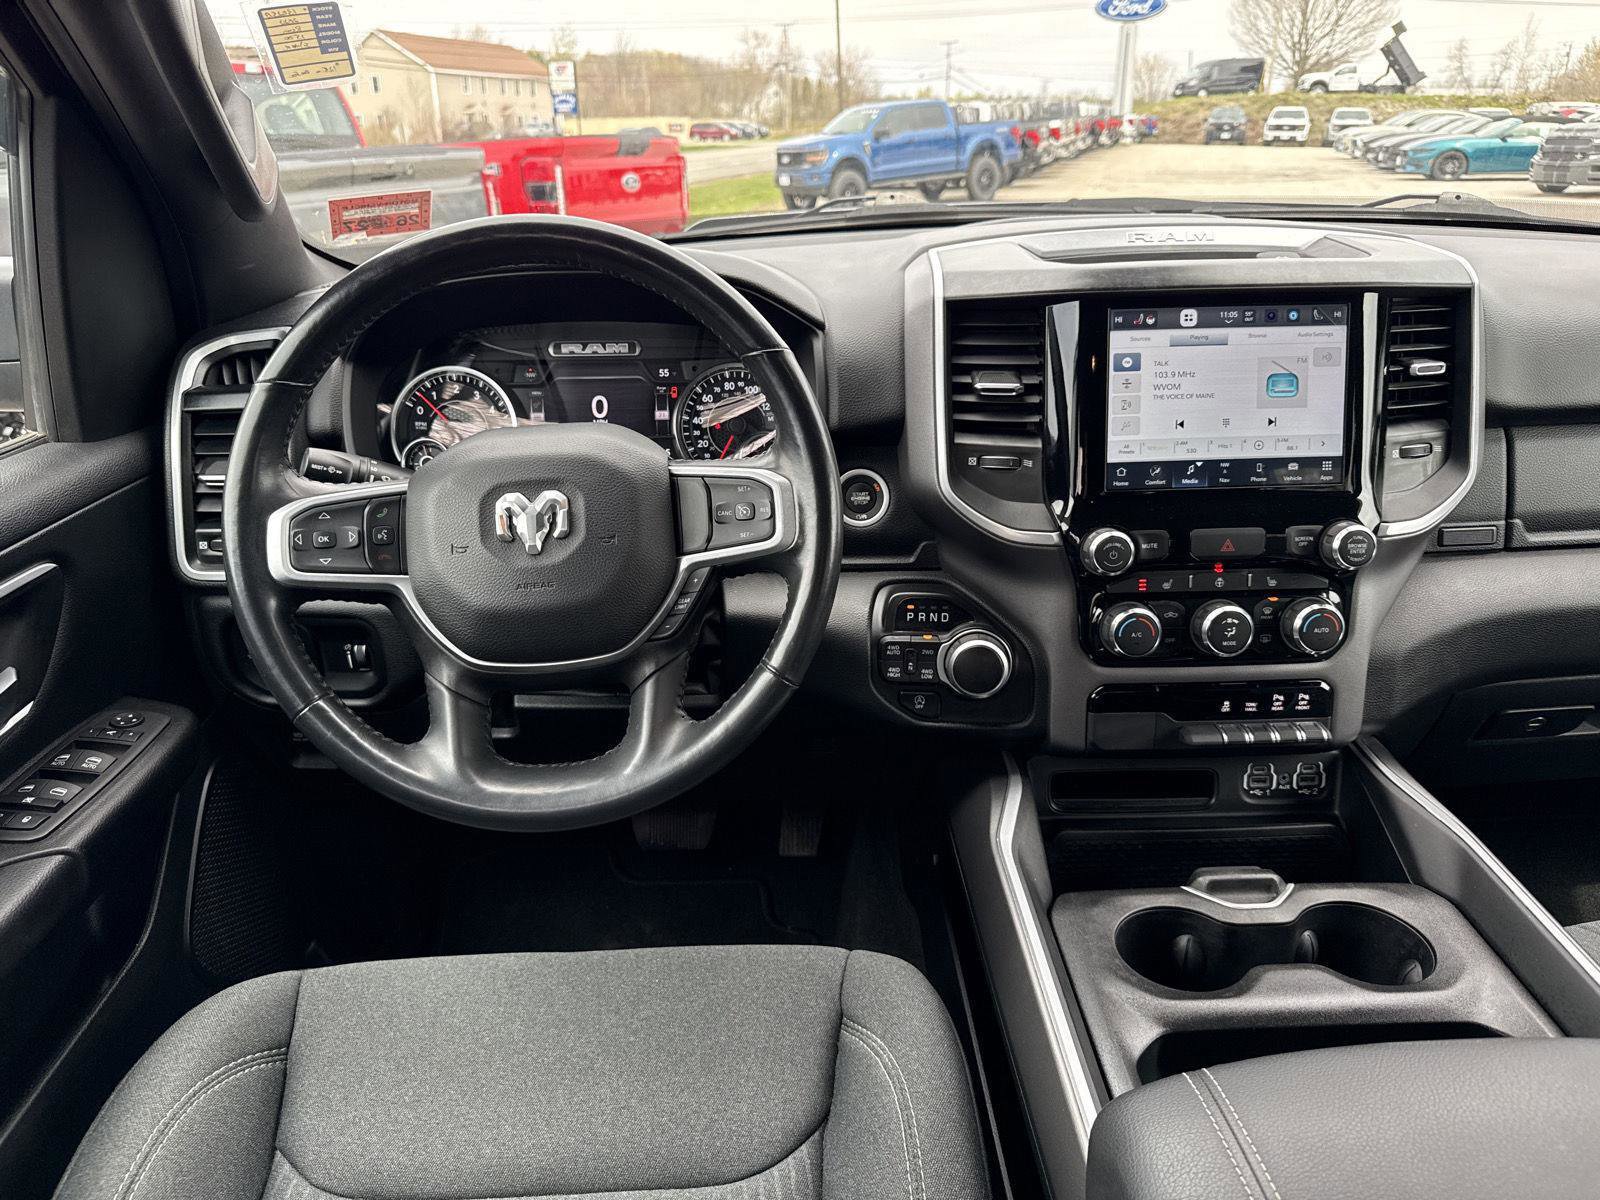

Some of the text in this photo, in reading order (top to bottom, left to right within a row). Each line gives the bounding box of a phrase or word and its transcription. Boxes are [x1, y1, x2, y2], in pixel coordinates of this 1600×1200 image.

[1126, 231, 1214, 243] RAM
[560, 343, 629, 354] RAM
[659, 369, 670, 378] 55
[1154, 370, 1196, 379] 103.9 MHz
[453, 385, 460, 394] 2
[724, 382, 735, 390] 80
[744, 385, 760, 394] 100
[1153, 383, 1181, 391] WVOM
[432, 391, 437, 400] 1
[474, 390, 480, 399] 3
[702, 394, 713, 403] 60
[416, 406, 424, 415] 0
[591, 395, 608, 419] 0
[692, 417, 704, 425] 40
[515, 581, 556, 591] AIRBAG
[907, 612, 949, 622] P R N D
